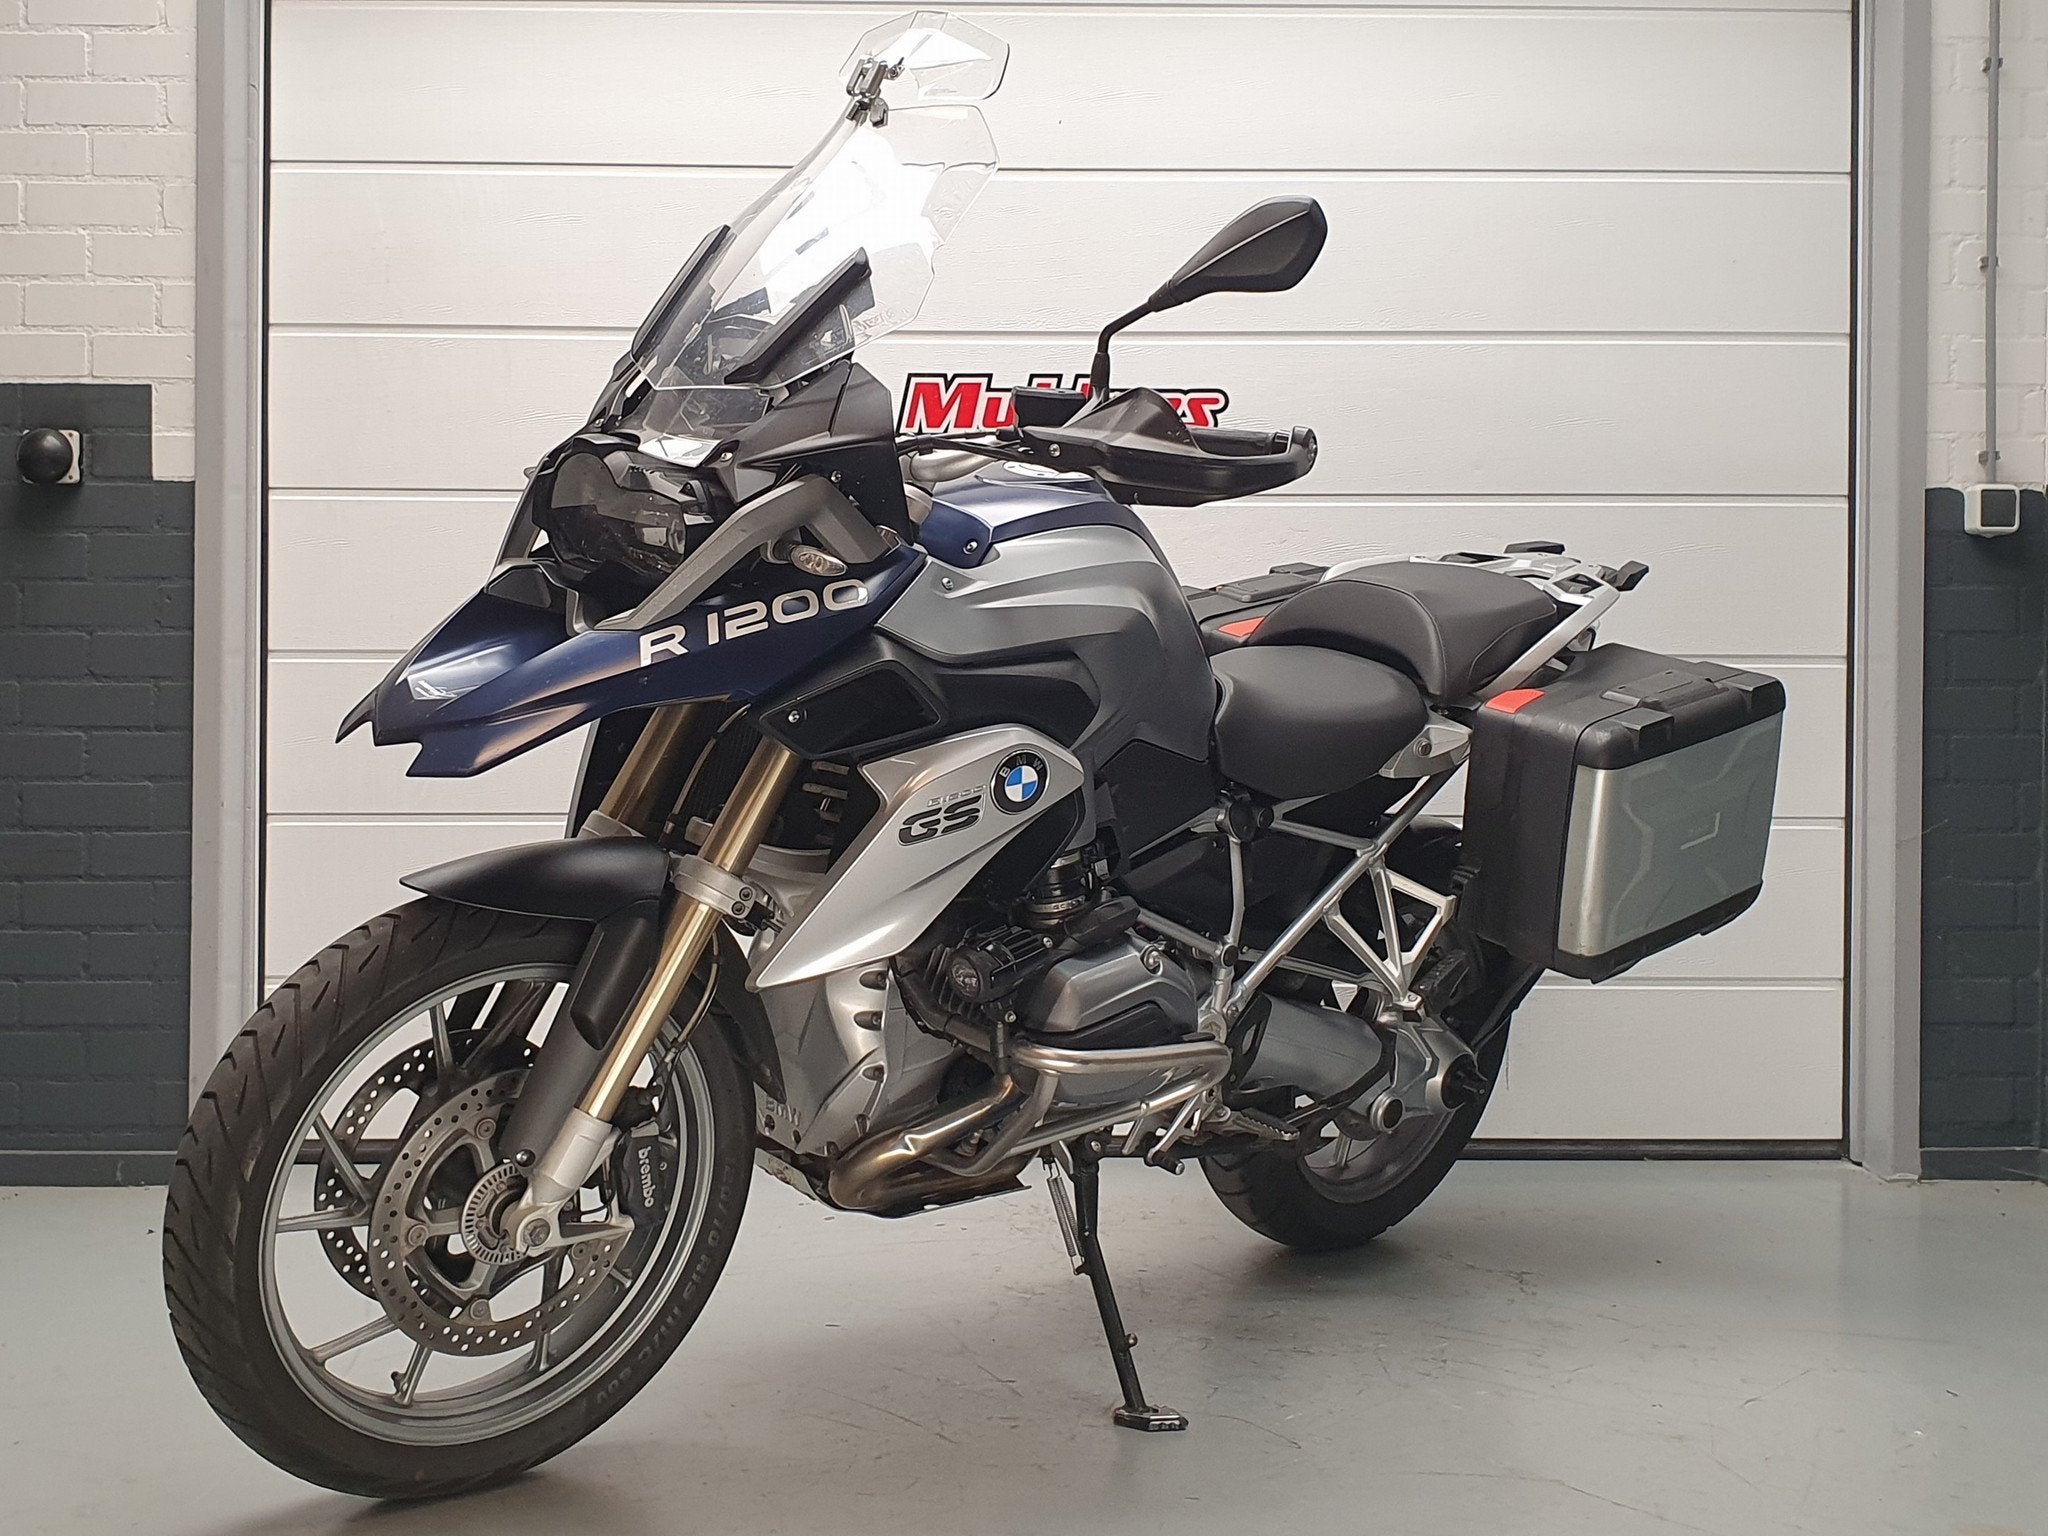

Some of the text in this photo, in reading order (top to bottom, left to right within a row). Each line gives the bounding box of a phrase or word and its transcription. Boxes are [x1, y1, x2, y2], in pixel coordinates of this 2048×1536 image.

[639, 579, 869, 667] R 1200
[999, 755, 1043, 778] BMW
[898, 794, 982, 846] GS
[638, 1146, 656, 1208] brembo
